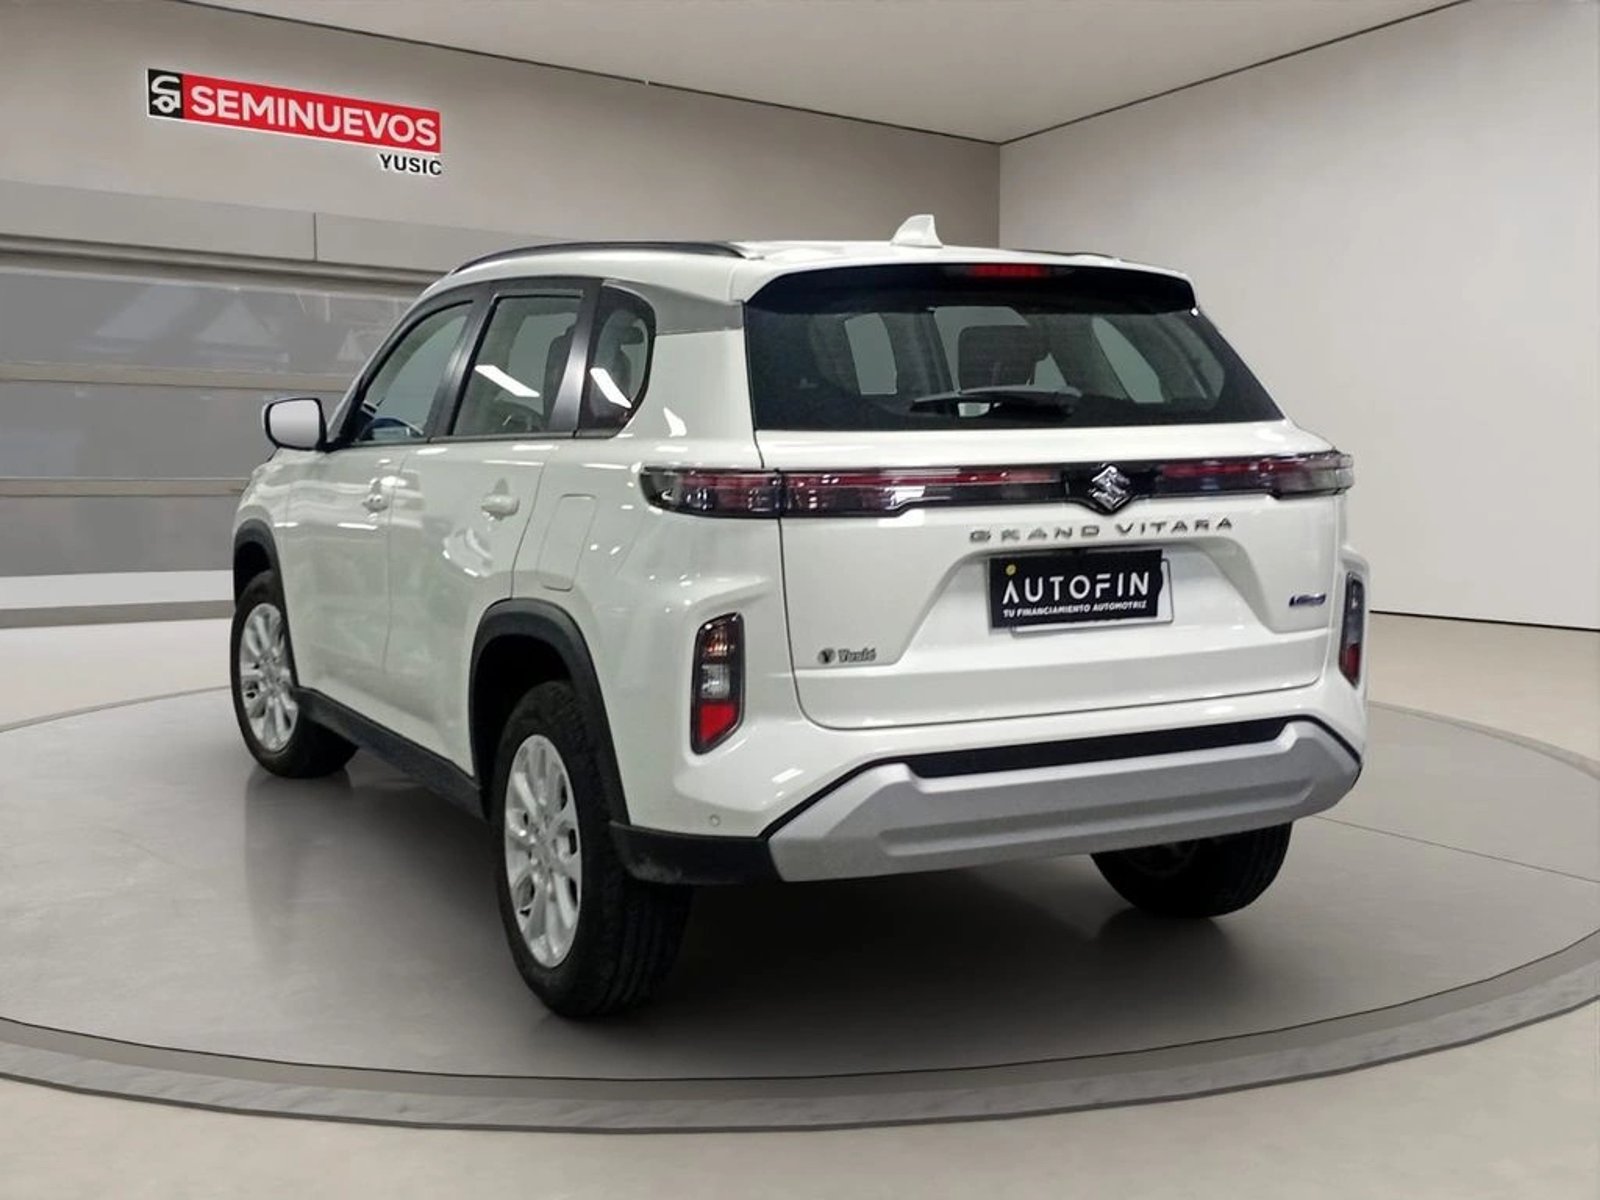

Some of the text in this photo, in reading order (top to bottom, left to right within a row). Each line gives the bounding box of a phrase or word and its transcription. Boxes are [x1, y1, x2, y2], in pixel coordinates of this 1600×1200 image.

[191, 85, 437, 146] SEMINUEVOS
[969, 517, 1233, 543] GRAND VITARA
[1002, 571, 1149, 604] AUTOFIN
[1003, 600, 1147, 617] TU FINANCIAMIENTO AUTOMOTRIZ
